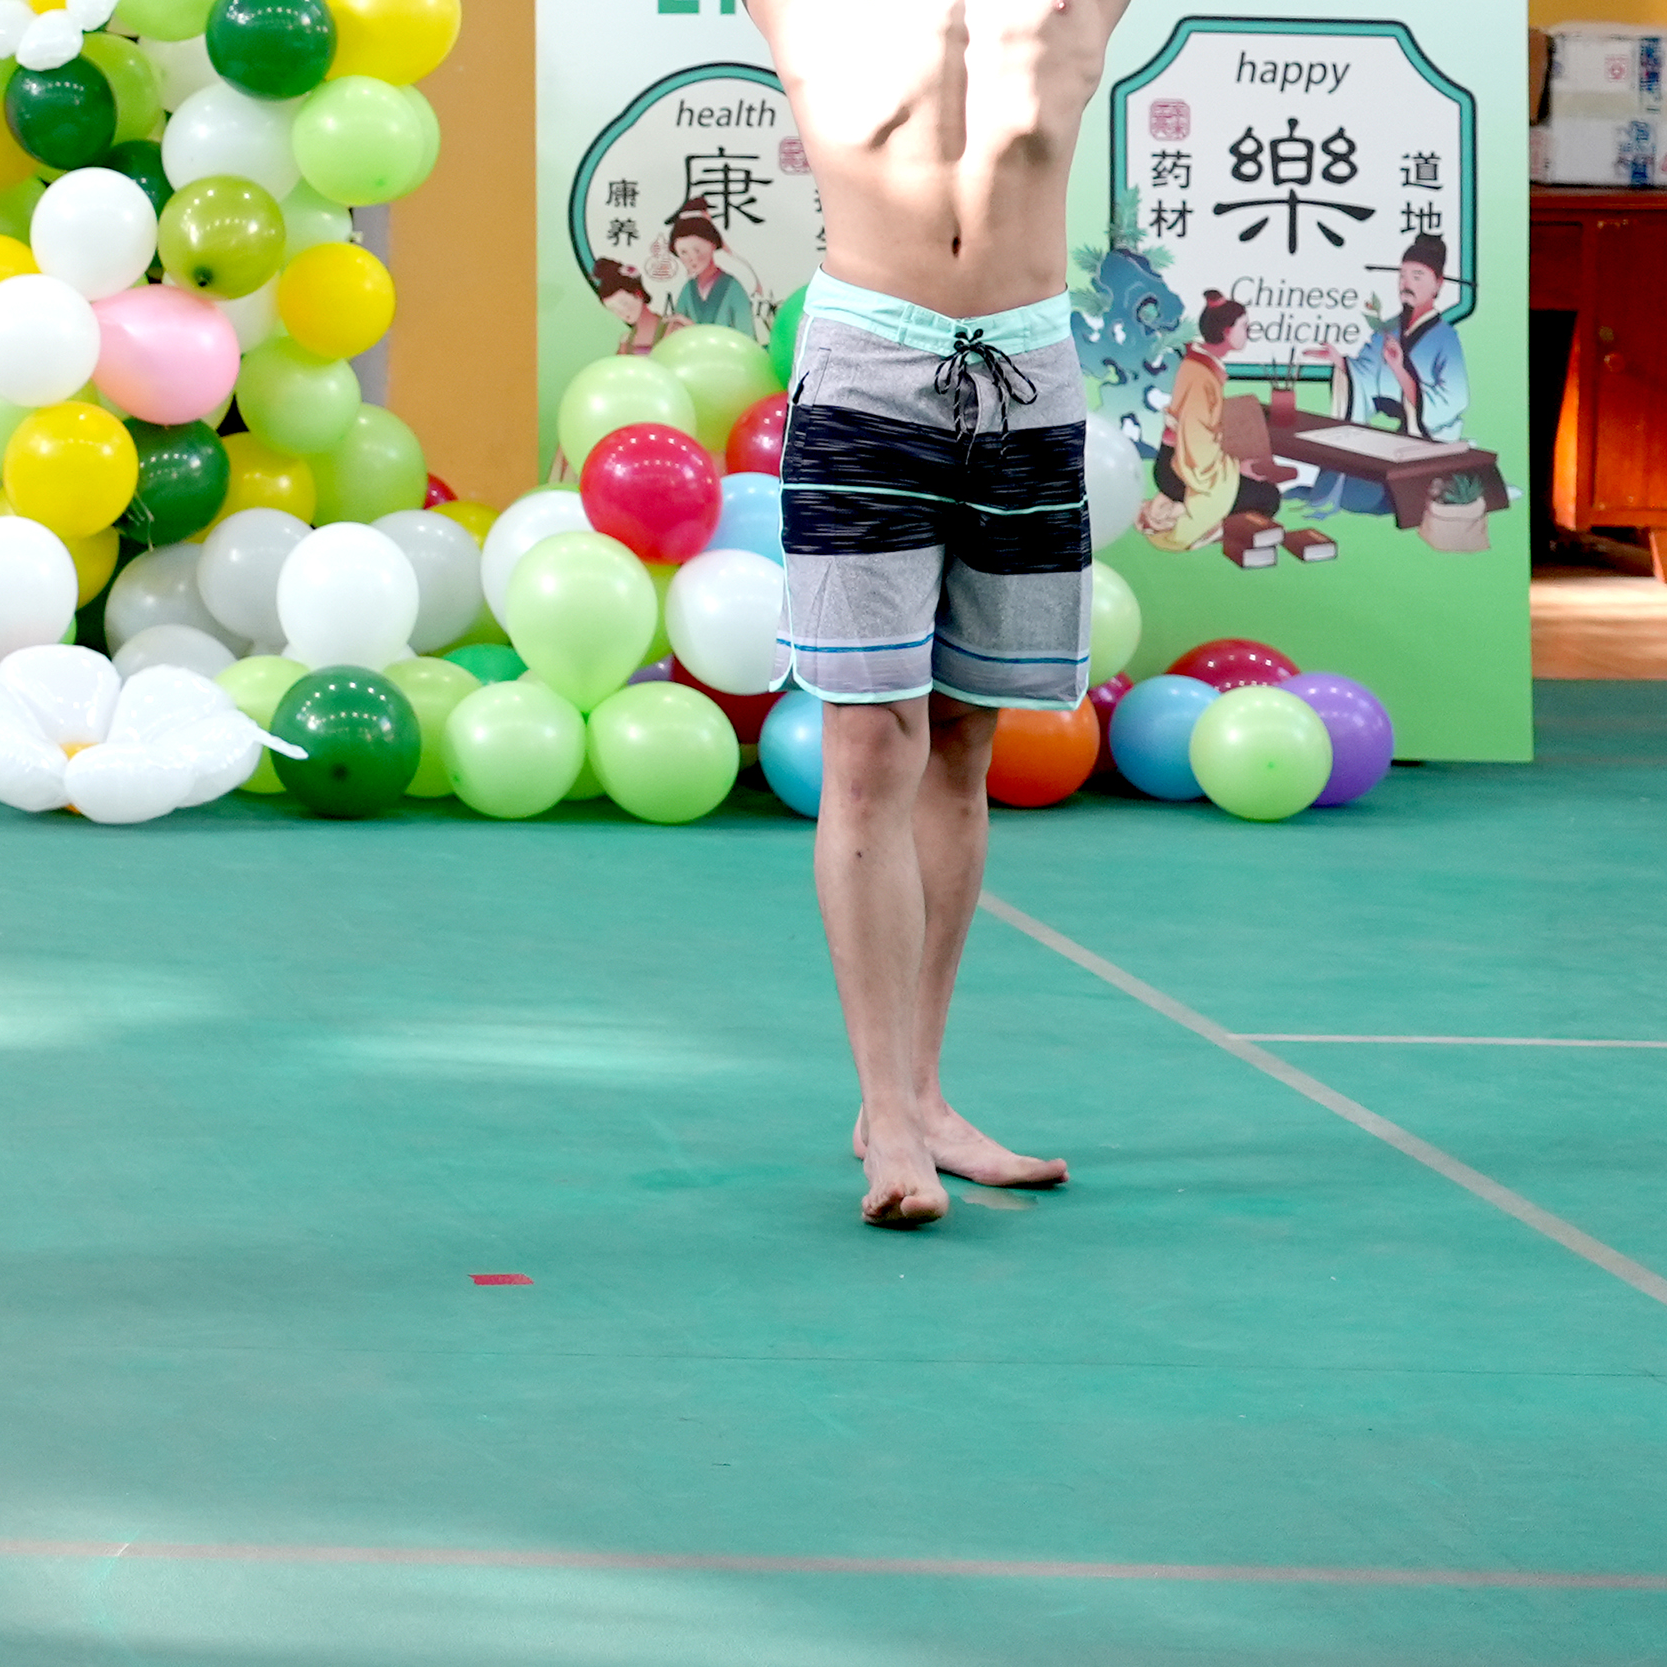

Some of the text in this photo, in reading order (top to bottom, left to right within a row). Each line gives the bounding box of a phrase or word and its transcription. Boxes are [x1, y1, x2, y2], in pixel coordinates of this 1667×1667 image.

[1235, 50, 1351, 94] happy
[675, 98, 776, 128] health
[605, 178, 641, 248] 康养
[1149, 149, 1194, 239] 药材
[1399, 150, 1444, 235] 道地
[1229, 275, 1359, 310] Chinese
[1246, 313, 1361, 346] edicine
